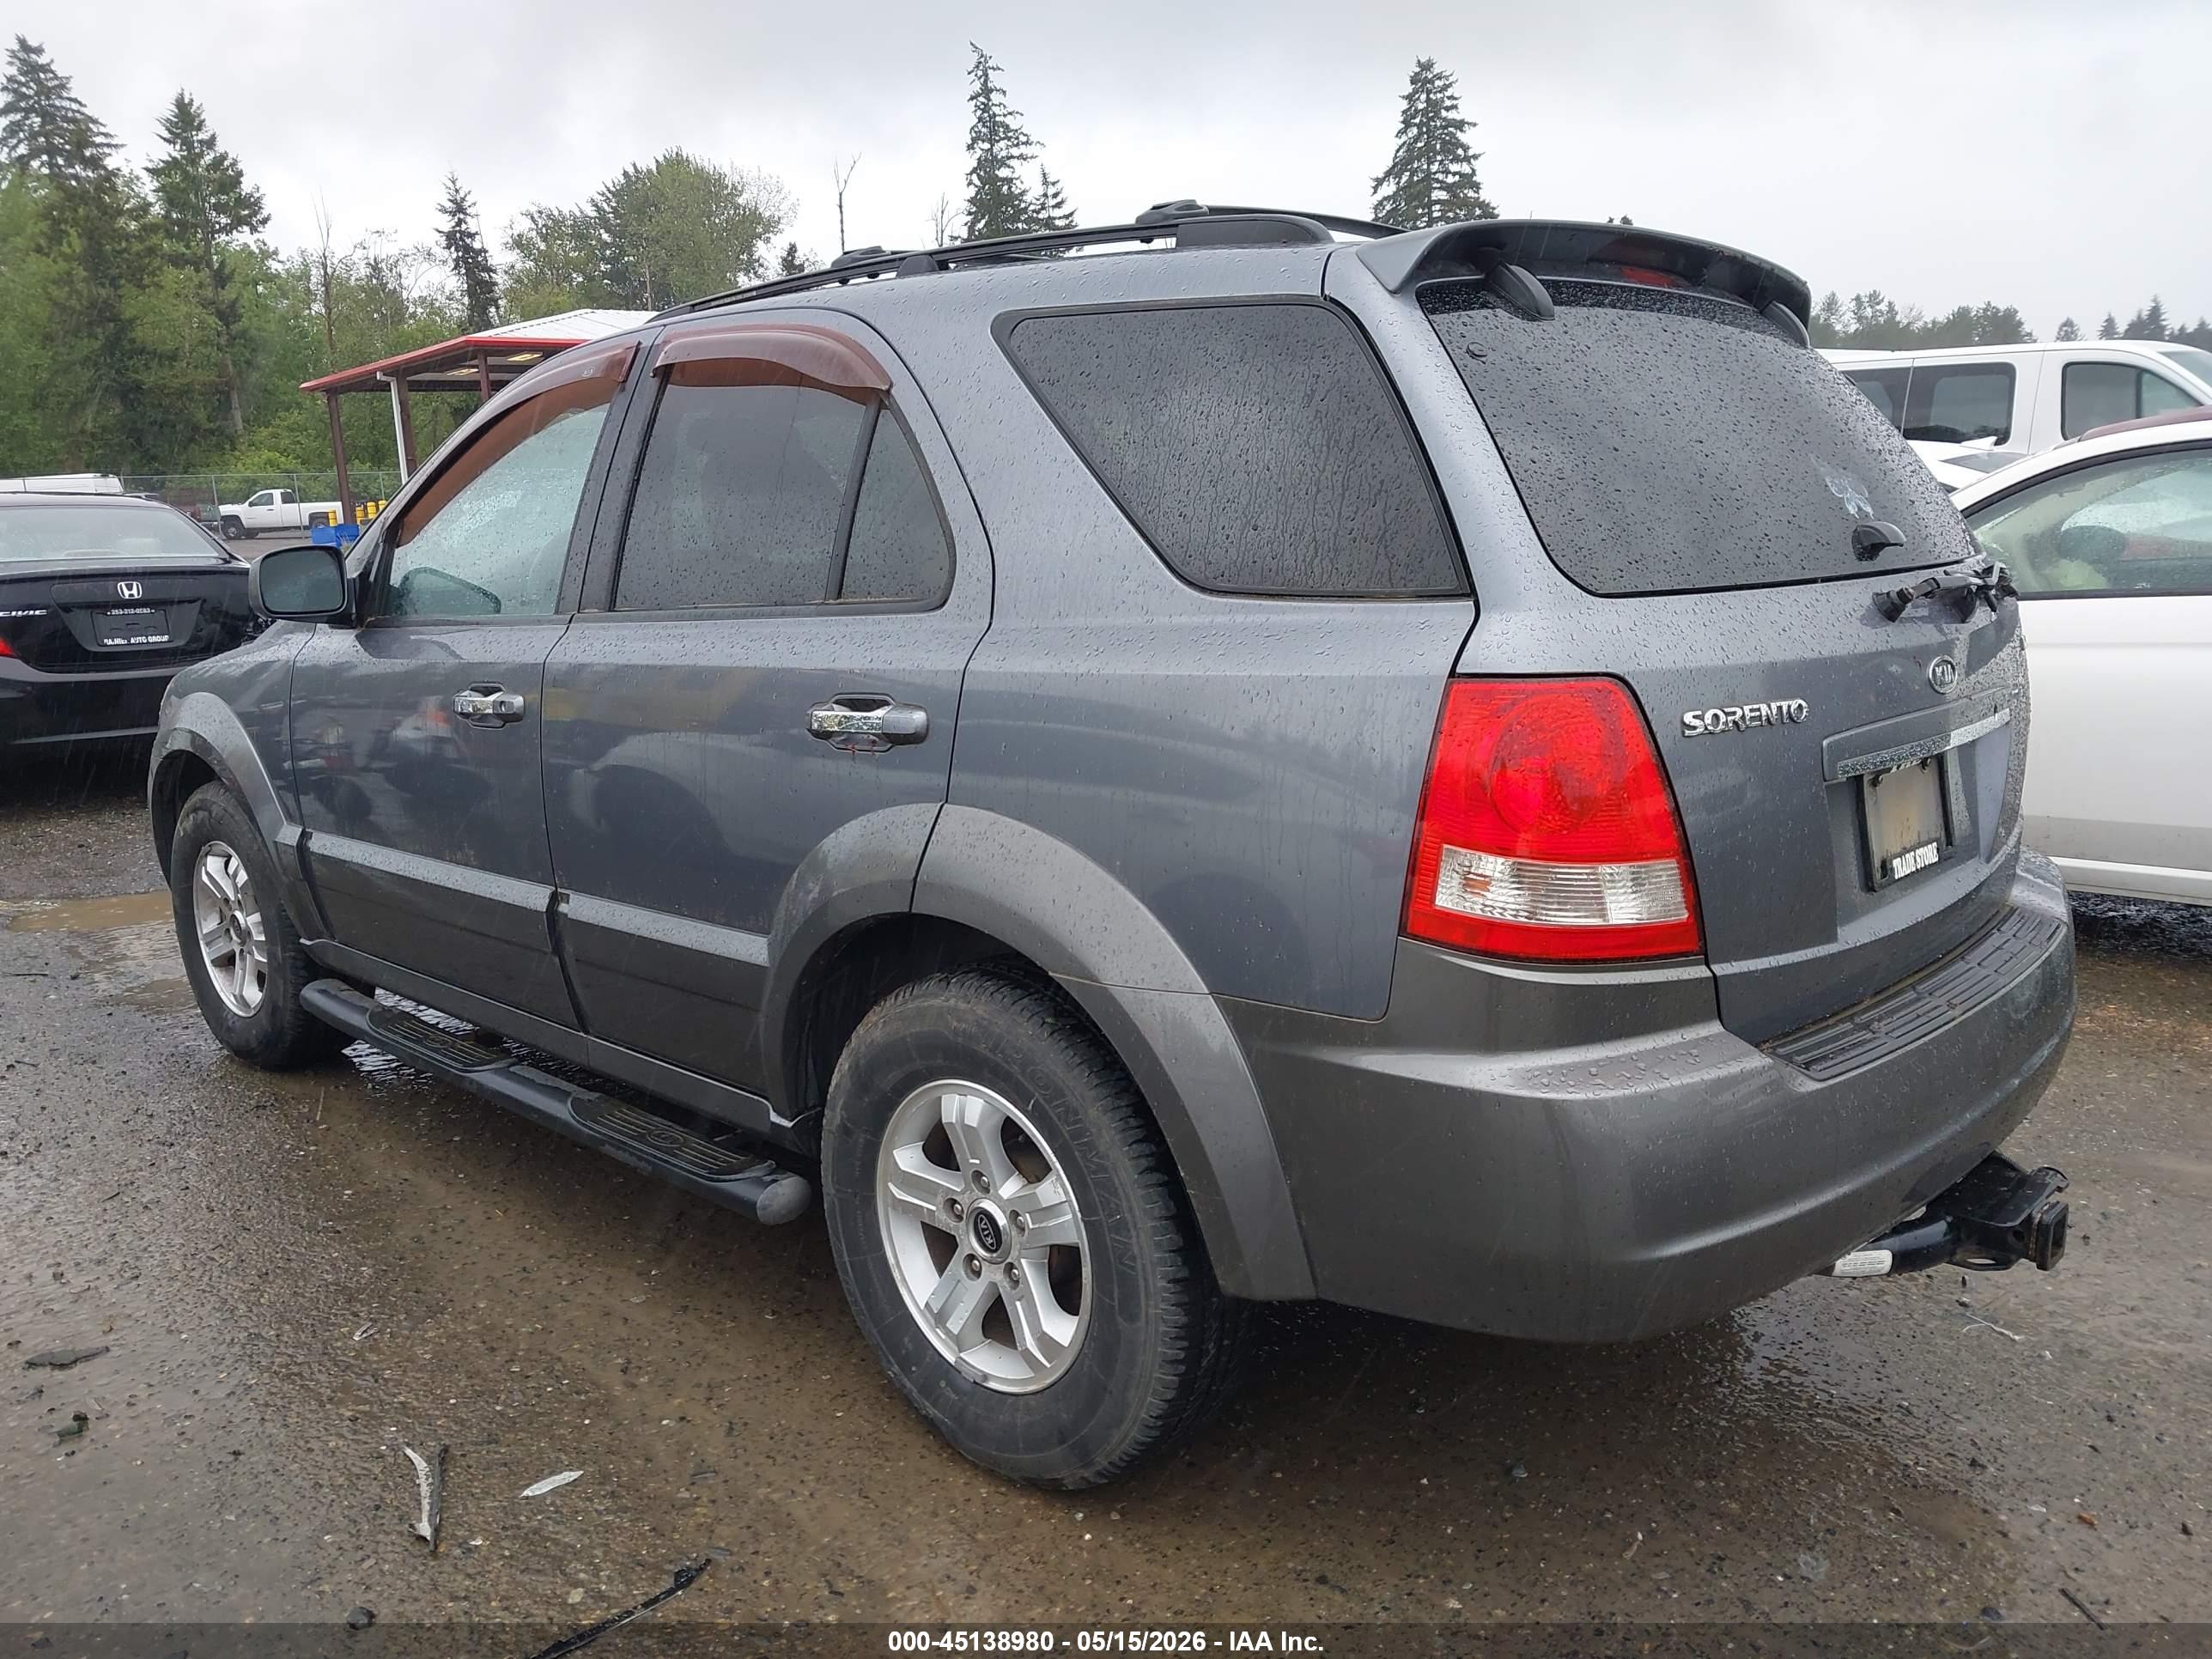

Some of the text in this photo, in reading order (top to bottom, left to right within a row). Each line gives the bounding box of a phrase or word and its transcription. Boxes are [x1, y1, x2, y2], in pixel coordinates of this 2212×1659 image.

[0, 609, 48, 617] CIVIC
[130, 635, 148, 644] AUTO
[148, 635, 170, 643] GROUP
[1683, 698, 1809, 736] SORENTO
[1892, 841, 1939, 880] TRADE STORE
